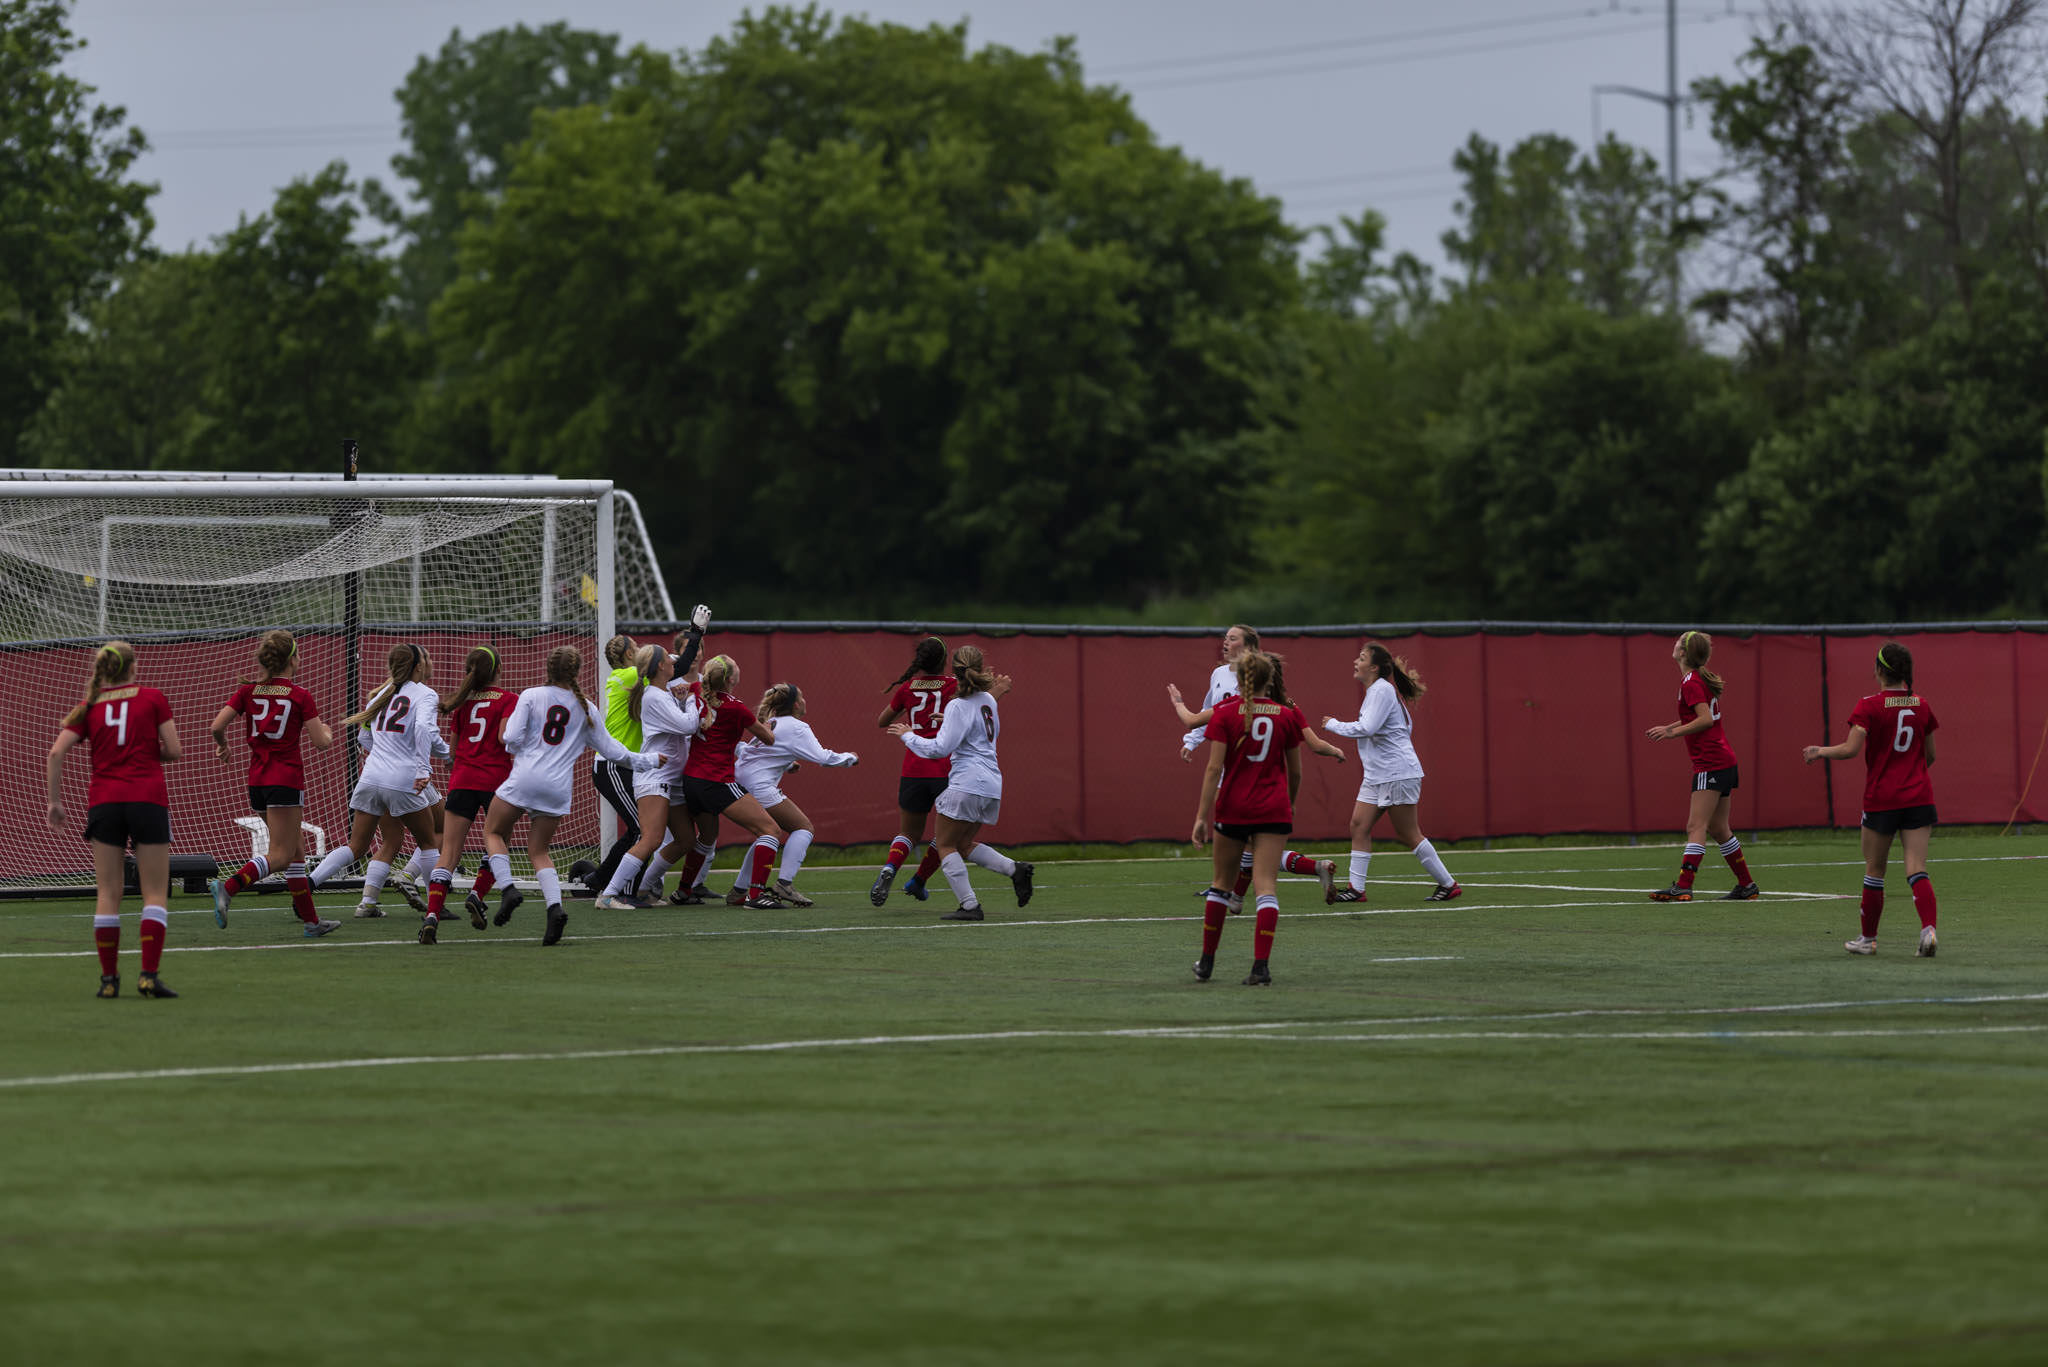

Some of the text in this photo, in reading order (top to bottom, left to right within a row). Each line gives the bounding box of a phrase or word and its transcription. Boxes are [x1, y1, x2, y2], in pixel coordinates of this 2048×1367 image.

[104, 703, 129, 746] 4
[252, 699, 292, 740] 23
[376, 695, 411, 734] 12
[469, 701, 491, 744] 5
[543, 704, 570, 746] 8
[910, 691, 943, 731] 21
[981, 705, 995, 743] 6
[1894, 709, 1915, 752] 6
[1246, 716, 1274, 762] 9
